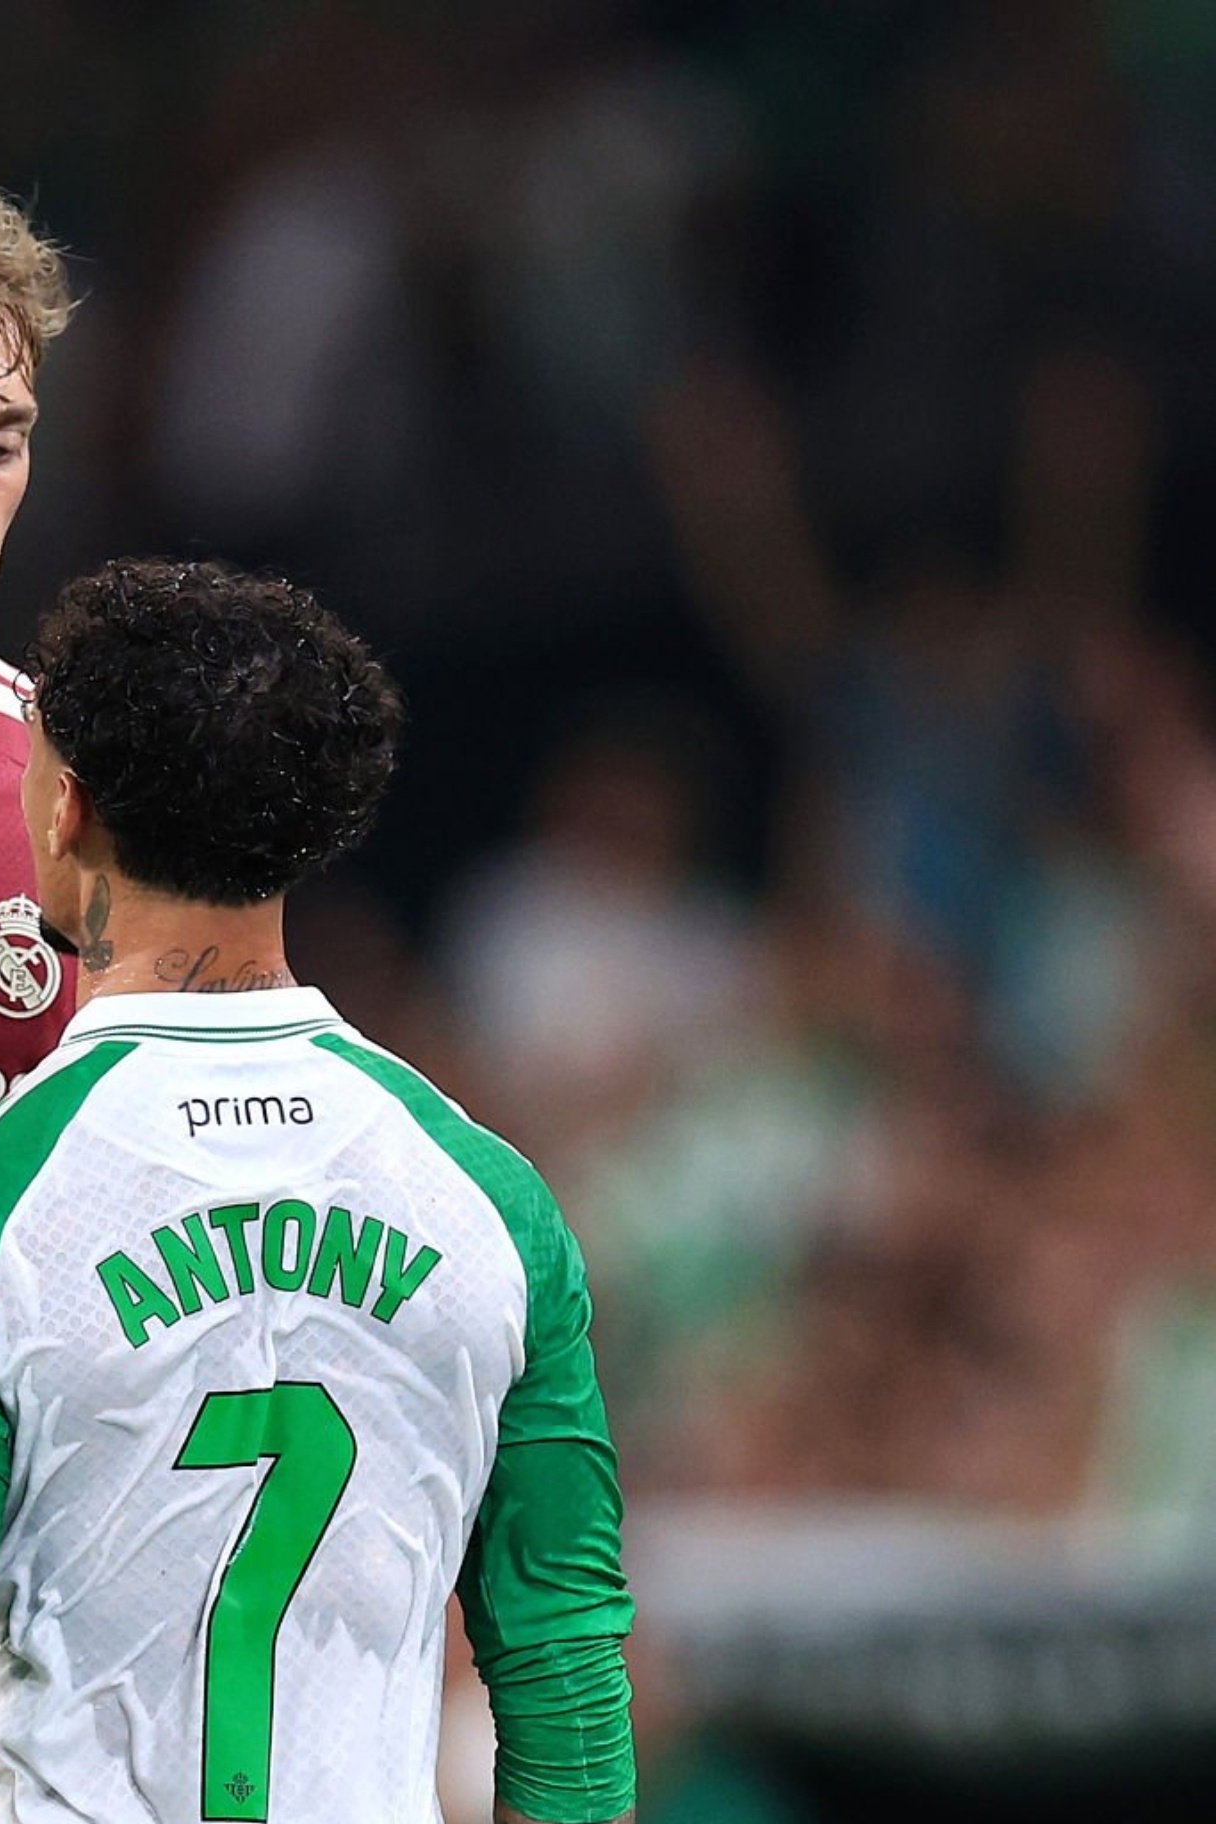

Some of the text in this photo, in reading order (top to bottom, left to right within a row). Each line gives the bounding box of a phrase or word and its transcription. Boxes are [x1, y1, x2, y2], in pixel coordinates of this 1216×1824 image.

[178, 1096, 314, 1137] prima
[96, 1198, 443, 1349] ANTONY
[171, 1380, 358, 1824] 7
